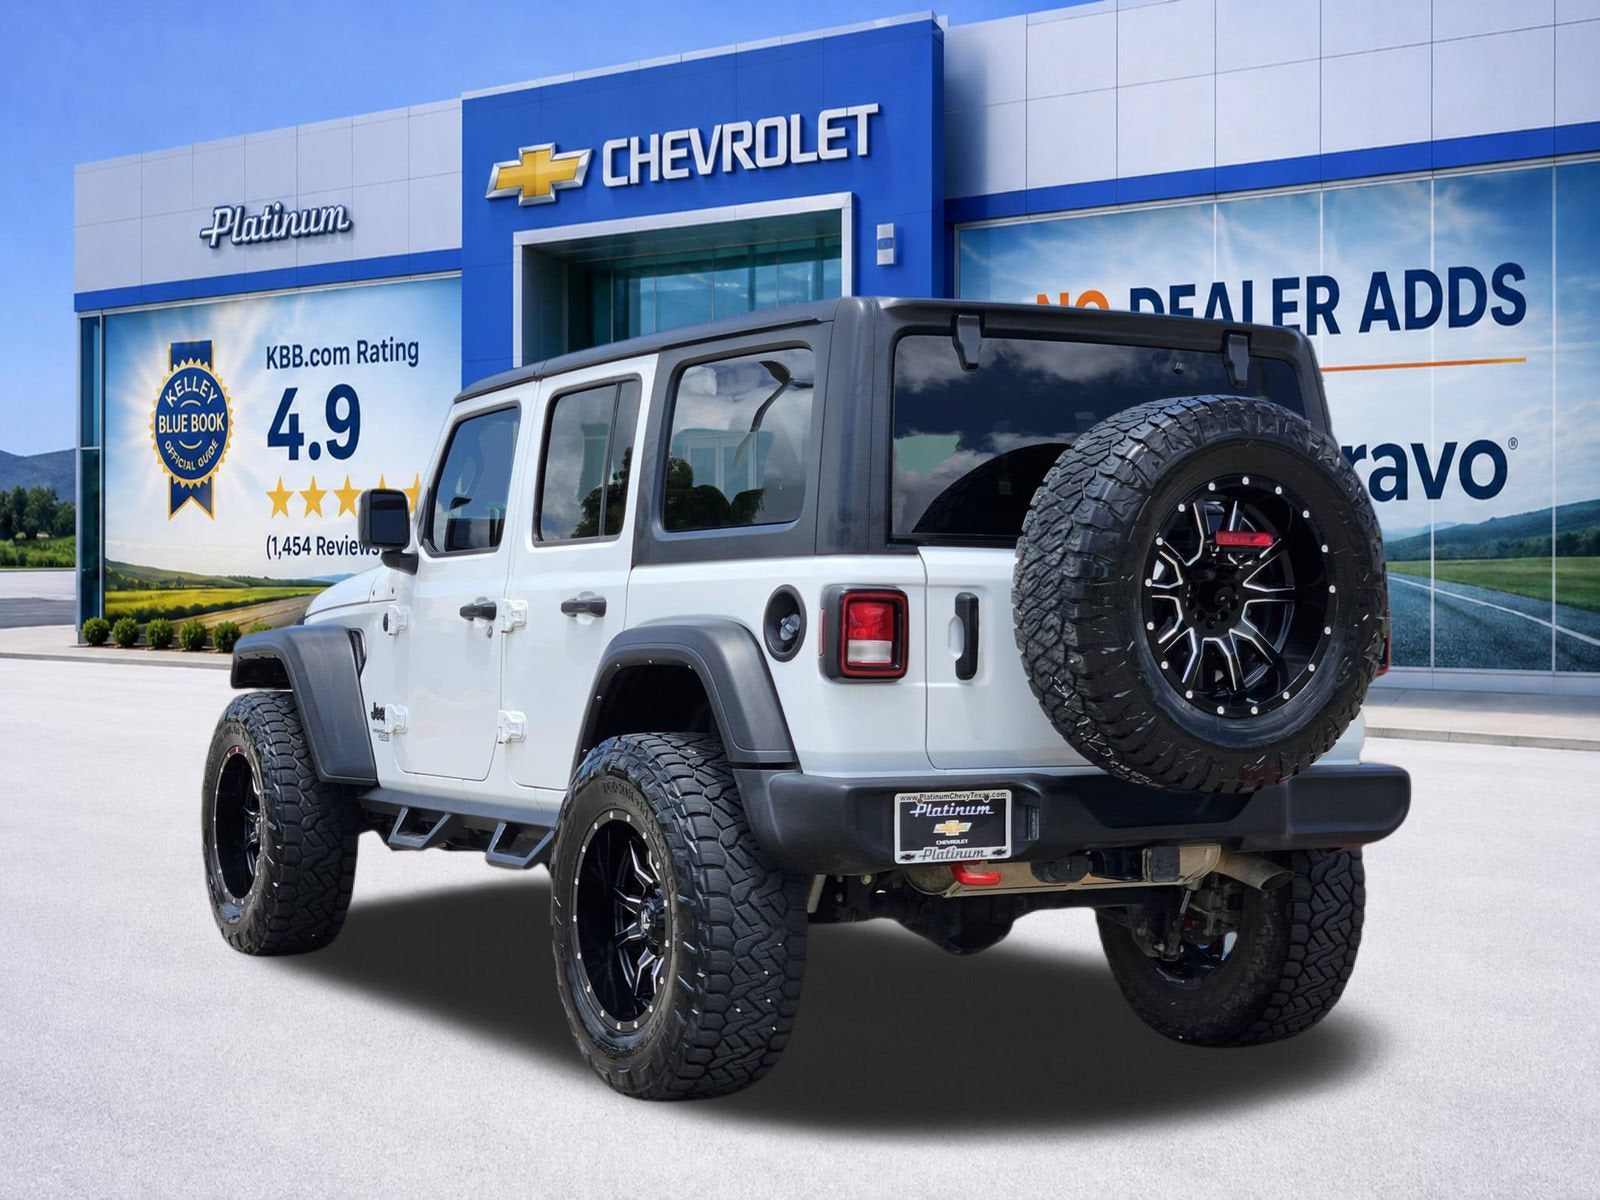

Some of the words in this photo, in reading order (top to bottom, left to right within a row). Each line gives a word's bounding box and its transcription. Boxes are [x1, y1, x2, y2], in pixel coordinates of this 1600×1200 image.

[602, 103, 879, 188] CHEVROLET
[199, 201, 353, 248] Platinum
[1358, 262, 1527, 333] ADDS
[266, 344, 350, 370] KBB.com
[356, 336, 419, 367] Rating
[165, 376, 218, 407] KELLEY
[158, 414, 188, 433] BLUE
[192, 413, 225, 432] BOOK
[267, 383, 361, 461] 4.9
[164, 440, 196, 471] OFFICIAL
[266, 534, 311, 559] (1,454
[901, 791, 1007, 801] www.PlatinumChevyTex.com
[909, 803, 994, 817] Platinum
[920, 846, 988, 860] Platinum
